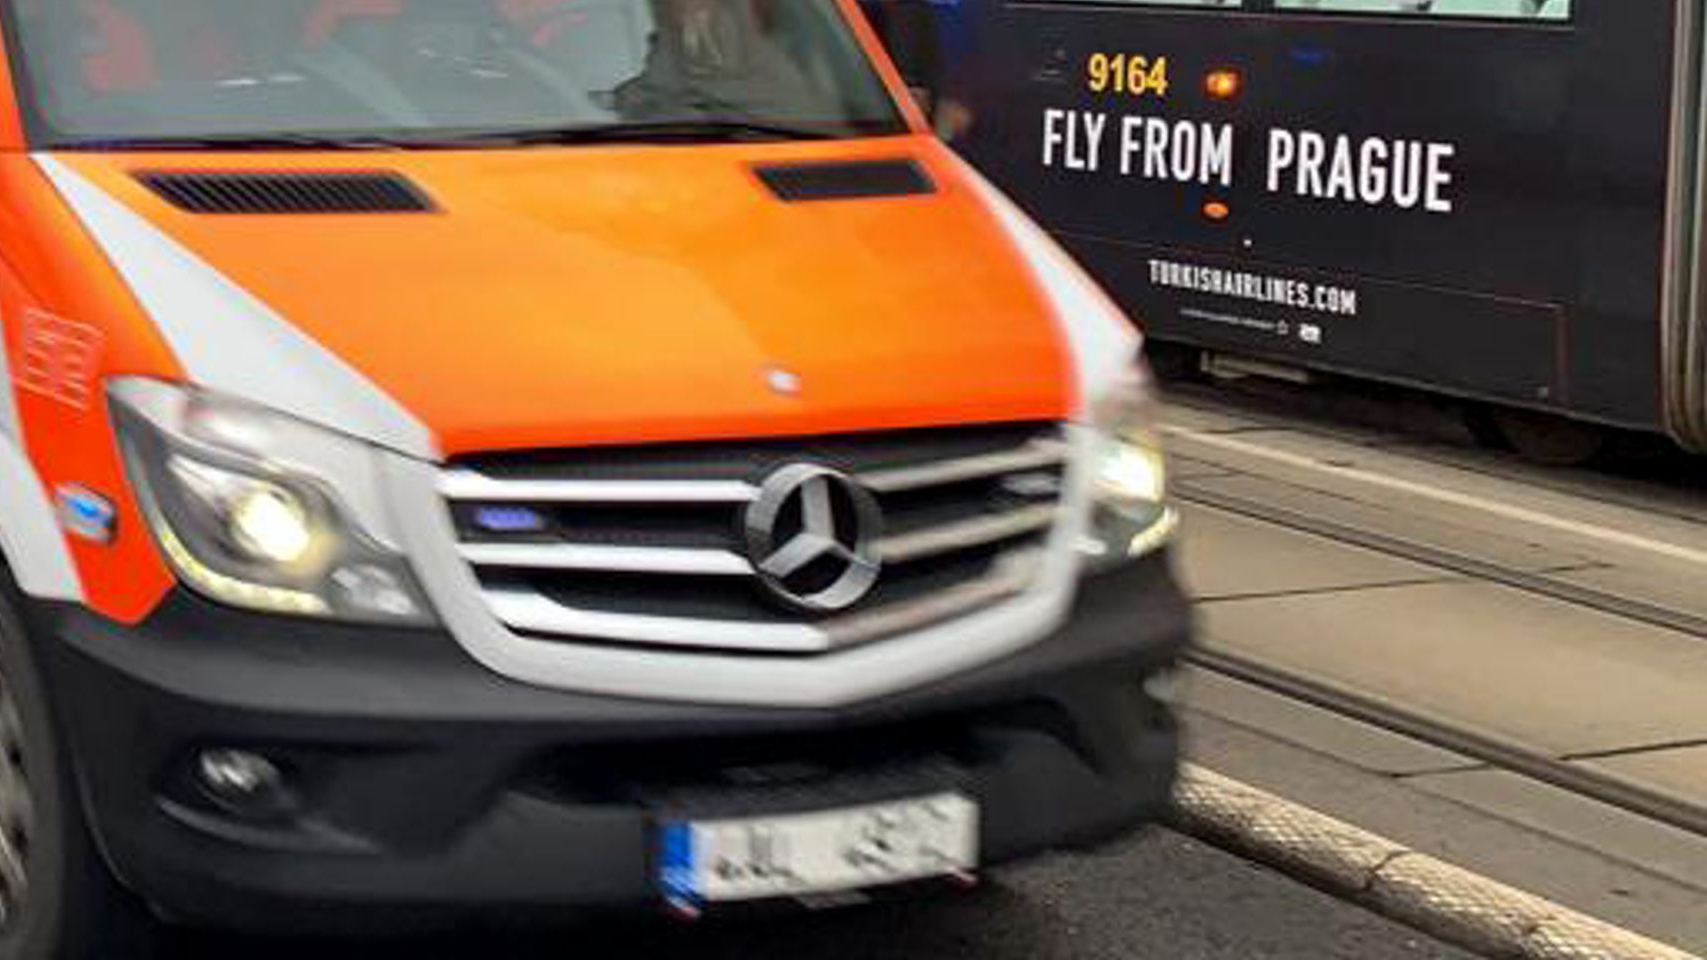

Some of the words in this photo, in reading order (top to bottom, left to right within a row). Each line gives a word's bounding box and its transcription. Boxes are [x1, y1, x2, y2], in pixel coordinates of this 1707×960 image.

[1088, 53, 1169, 95] 9164
[1042, 109, 1105, 171] FLY
[1120, 117, 1233, 187] FROM
[1267, 128, 1455, 212] PRAGUE
[1148, 259, 1357, 315] TURKISHAIRLINES.COM
